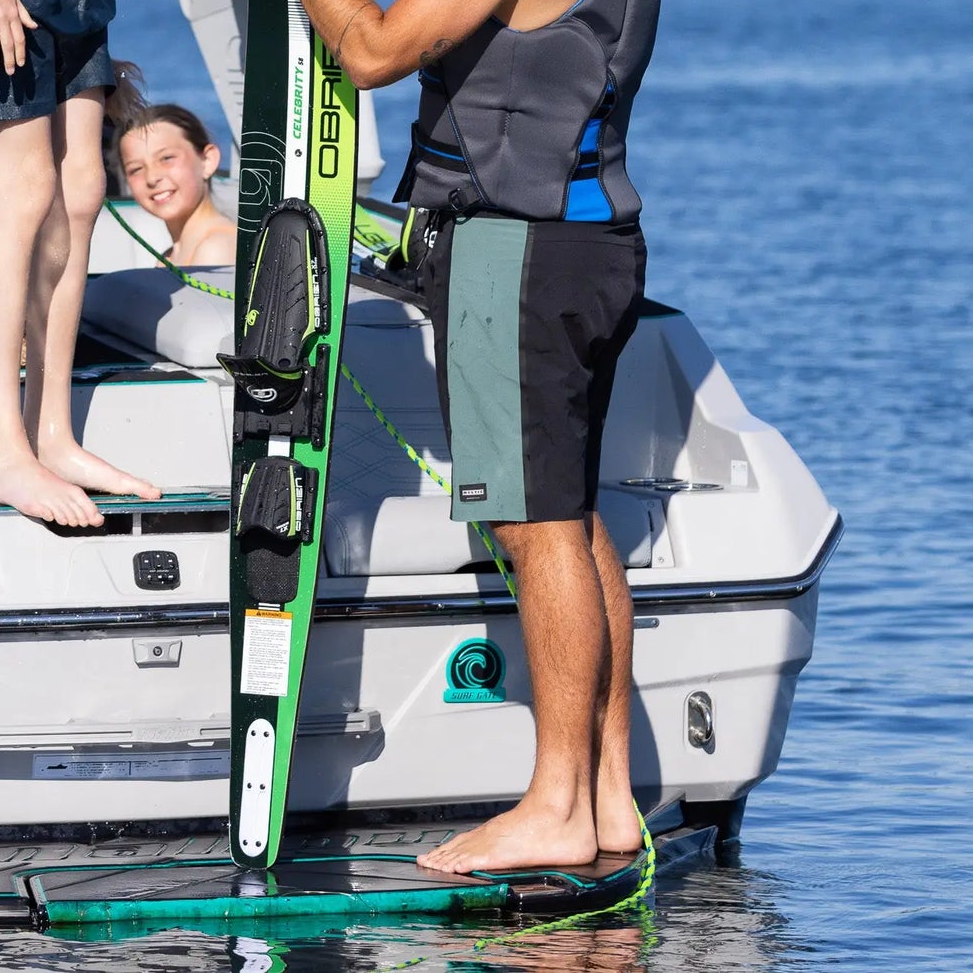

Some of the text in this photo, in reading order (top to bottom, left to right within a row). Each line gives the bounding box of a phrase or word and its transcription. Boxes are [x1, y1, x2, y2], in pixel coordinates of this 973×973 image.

[292, 66, 305, 139] CELEBRITY
[318, 40, 342, 179] OBRIE
[294, 477, 303, 532] OBRIEN
[450, 691, 473, 700] SURF
